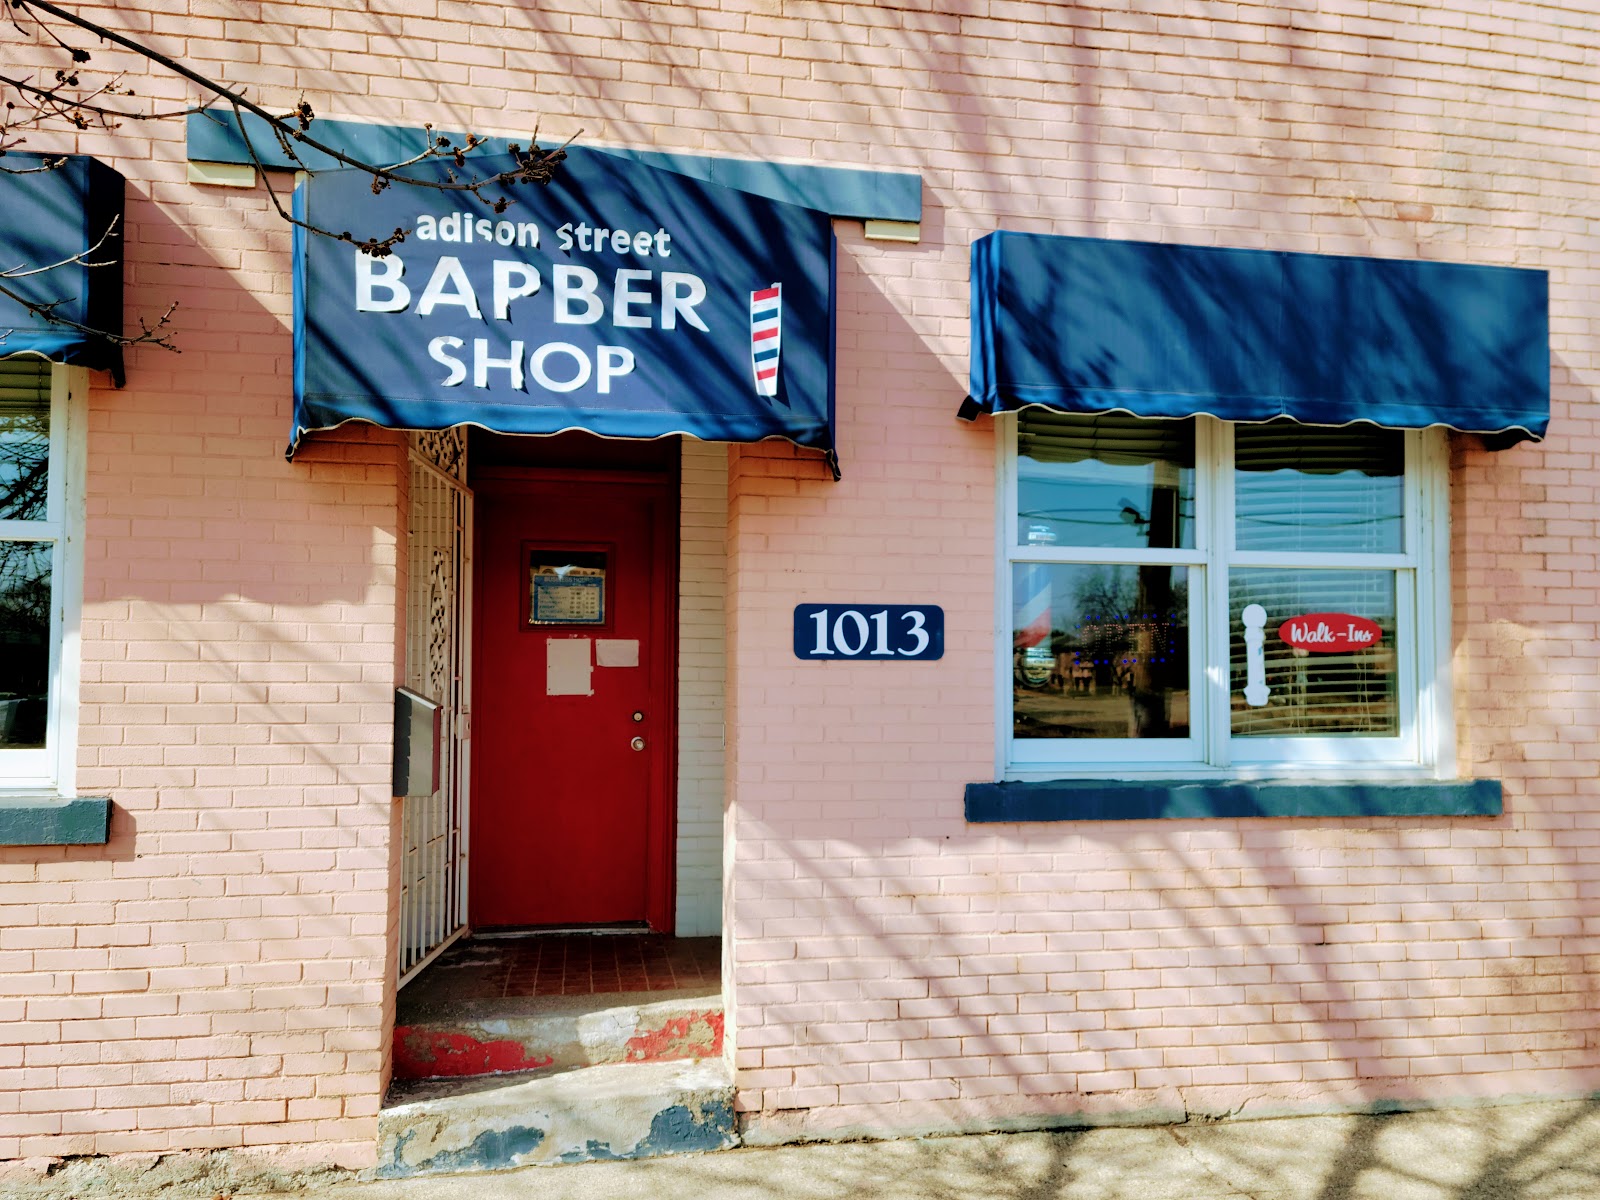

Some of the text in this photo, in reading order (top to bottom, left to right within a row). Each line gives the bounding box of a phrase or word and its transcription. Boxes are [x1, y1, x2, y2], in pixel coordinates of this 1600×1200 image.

[555, 221, 672, 257] street
[428, 335, 636, 394] SHOP
[809, 608, 930, 656] 1013
